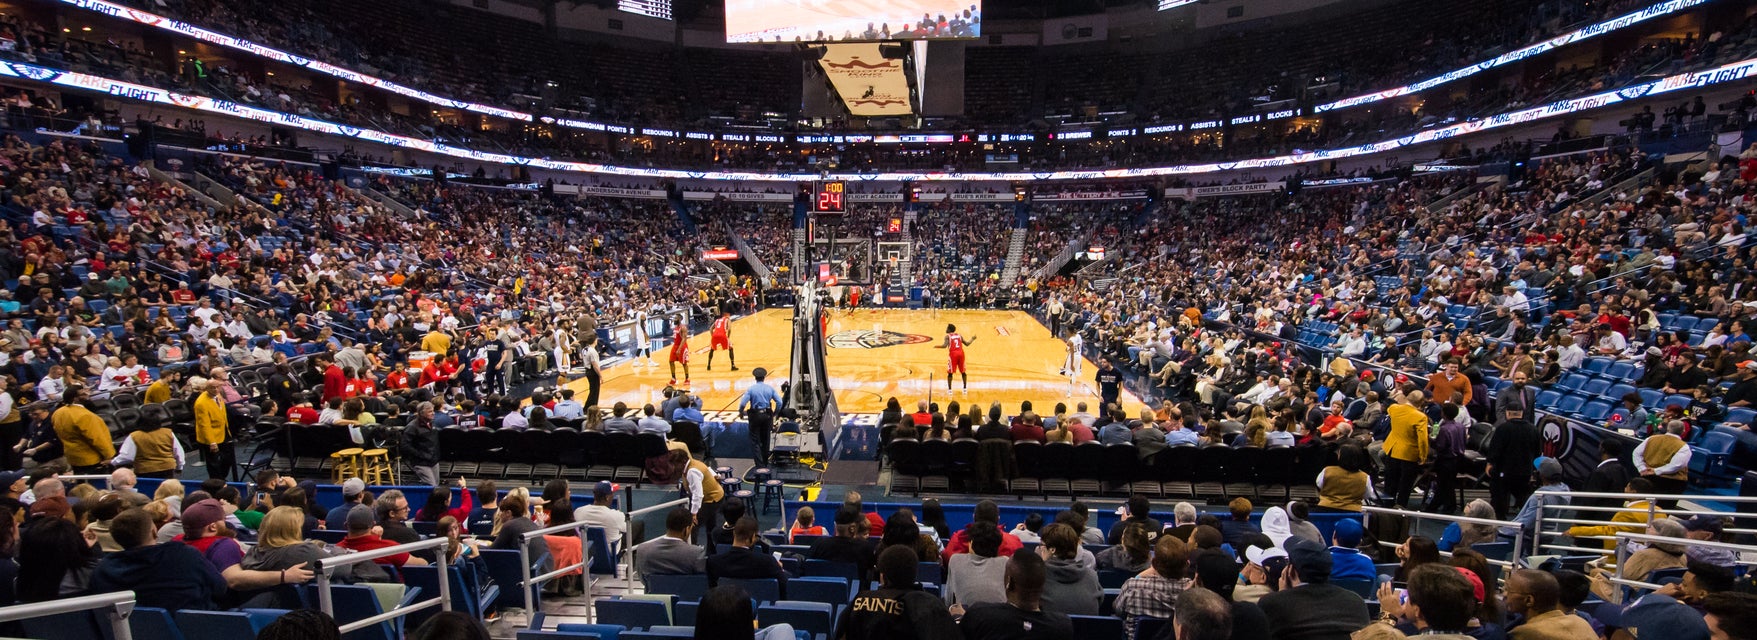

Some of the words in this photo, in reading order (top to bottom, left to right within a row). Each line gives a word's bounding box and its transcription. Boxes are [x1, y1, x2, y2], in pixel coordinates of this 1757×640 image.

[1640, 2, 1667, 18] TAKE
[170, 19, 194, 33] TAKE
[194, 30, 229, 45] FLIGHT
[1579, 24, 1601, 38] TAKE
[1599, 13, 1636, 34] FLIGHT
[233, 38, 254, 50] TAKE
[254, 46, 284, 60] FLIGHT
[1500, 50, 1519, 62] TAKE
[1517, 44, 1546, 60] FLIGHT
[315, 60, 333, 72] TAKE
[332, 68, 356, 80] FLIGHT
[1662, 71, 1697, 90] TAKE
[1695, 64, 1754, 87] FLIGHT
[72, 72, 109, 89] TAKE
[109, 84, 159, 101] FLIGHT
[1352, 94, 1377, 106] FLIGHT
[1546, 99, 1571, 113] TAKE
[1568, 94, 1611, 113] FLIGHT
[211, 100, 239, 113] TAKE
[239, 108, 277, 122] FLIGHT
[1489, 113, 1510, 126] TAKE
[1509, 109, 1542, 124] FLIGHT
[280, 113, 302, 125] TAKE
[302, 121, 334, 134] FLIGHT
[556, 118, 565, 127] 44
[566, 119, 606, 132] CUNNINGHAM
[607, 125, 628, 135] POINTS
[629, 127, 635, 135] 2
[642, 128, 674, 138] REBOUNDS
[685, 131, 709, 141] ASSISTS
[722, 133, 744, 142] STEALS
[755, 135, 778, 143] BLOCKS
[1065, 131, 1092, 140] BREWER
[1108, 129, 1130, 137] POINTS
[1144, 124, 1177, 135] REBOUNDS
[1190, 120, 1217, 130] ASSISTS
[1231, 115, 1254, 125] STEALS
[1267, 109, 1293, 120] BLOCKS
[1296, 108, 1301, 117] 1
[1432, 127, 1459, 141] FLIGHT
[1313, 149, 1330, 159] TAKE
[1358, 143, 1376, 153] TAKE
[548, 163, 574, 171] FLIGHT
[1258, 159, 1287, 168] FLIGHT
[725, 173, 750, 181] FLIGHT
[896, 174, 920, 182] FLIGHT
[1072, 172, 1098, 180] FLIGHT
[625, 188, 651, 196] AVENUE
[825, 183, 843, 193] 1:00
[1197, 186, 1221, 194] OMER'S
[1222, 185, 1244, 193] BLOCK
[1244, 183, 1267, 192] PARTY
[819, 192, 840, 210] 24
[954, 339, 960, 349] 2
[853, 597, 904, 615] SAINTS
